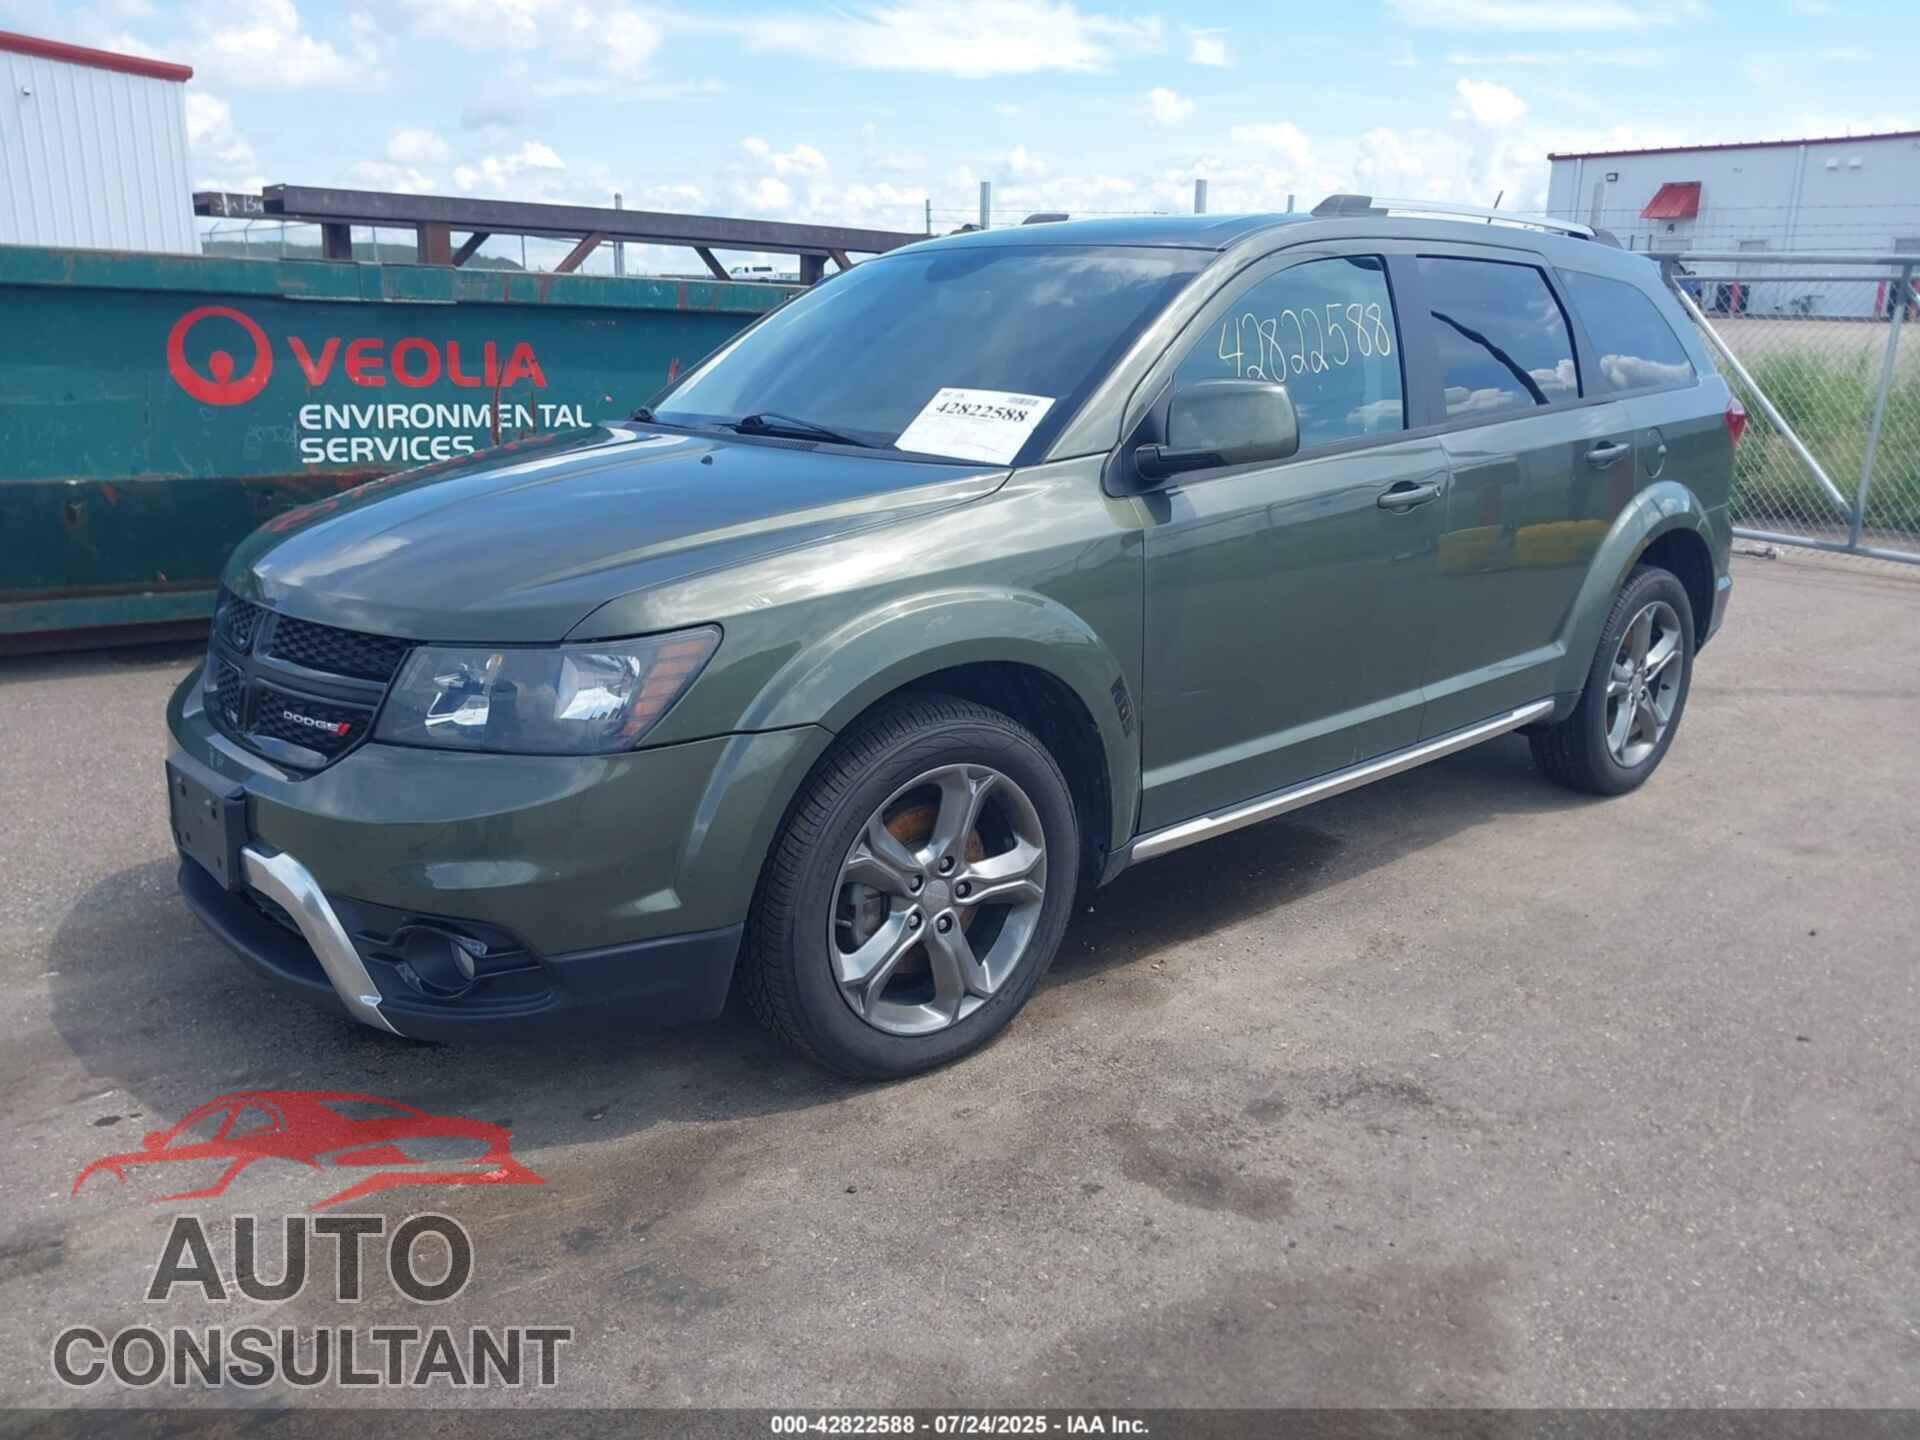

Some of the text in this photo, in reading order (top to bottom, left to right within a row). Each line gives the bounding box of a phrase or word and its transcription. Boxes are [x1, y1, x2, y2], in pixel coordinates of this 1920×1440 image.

[1218, 303, 1391, 382] 42822588
[287, 336, 547, 388] VEOLIA
[299, 404, 592, 430] ENVIRONMENTAL
[936, 401, 1029, 422] 42822588
[300, 435, 475, 463] SERVICES
[283, 710, 338, 732] DODGE
